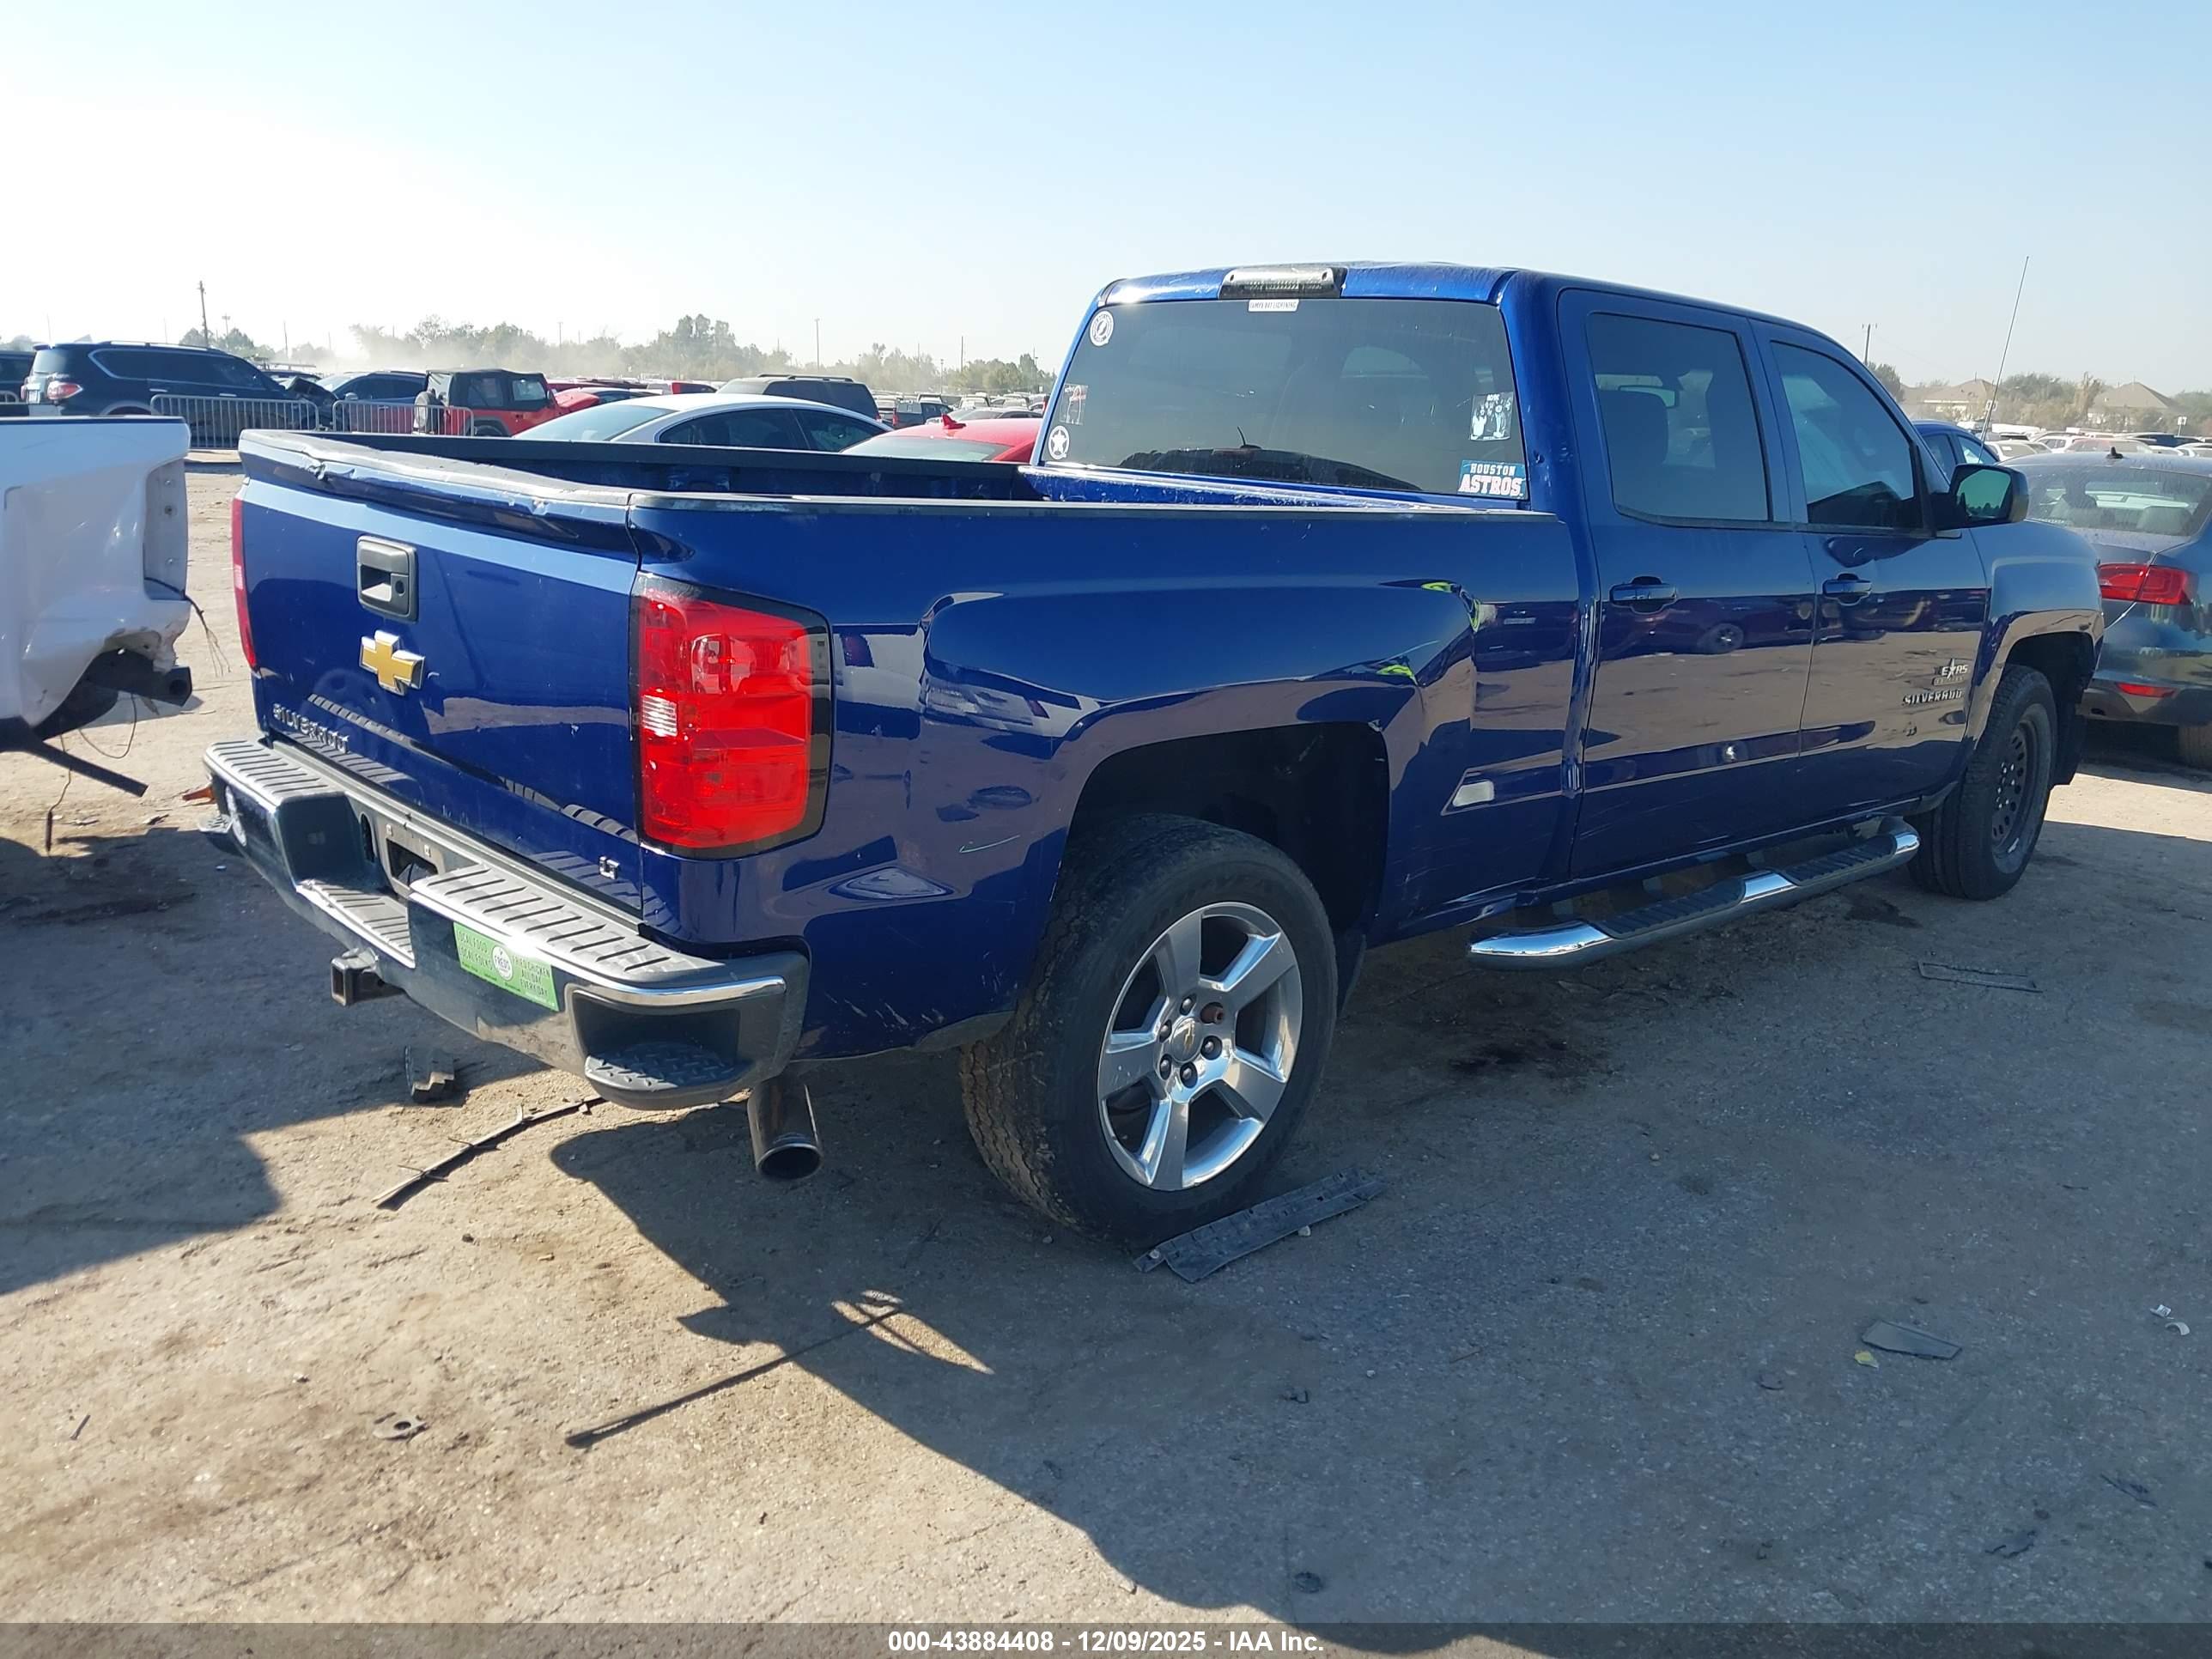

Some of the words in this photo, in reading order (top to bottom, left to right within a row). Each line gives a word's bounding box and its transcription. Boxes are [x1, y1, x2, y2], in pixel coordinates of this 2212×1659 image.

[1470, 463, 1516, 477] HOUSTON
[1458, 473, 1523, 497] ASTROS
[1934, 658, 1968, 679] TEXAS
[1903, 690, 1963, 705] SILVERADO
[273, 703, 349, 755] SILVERADO
[599, 856, 620, 880] LT
